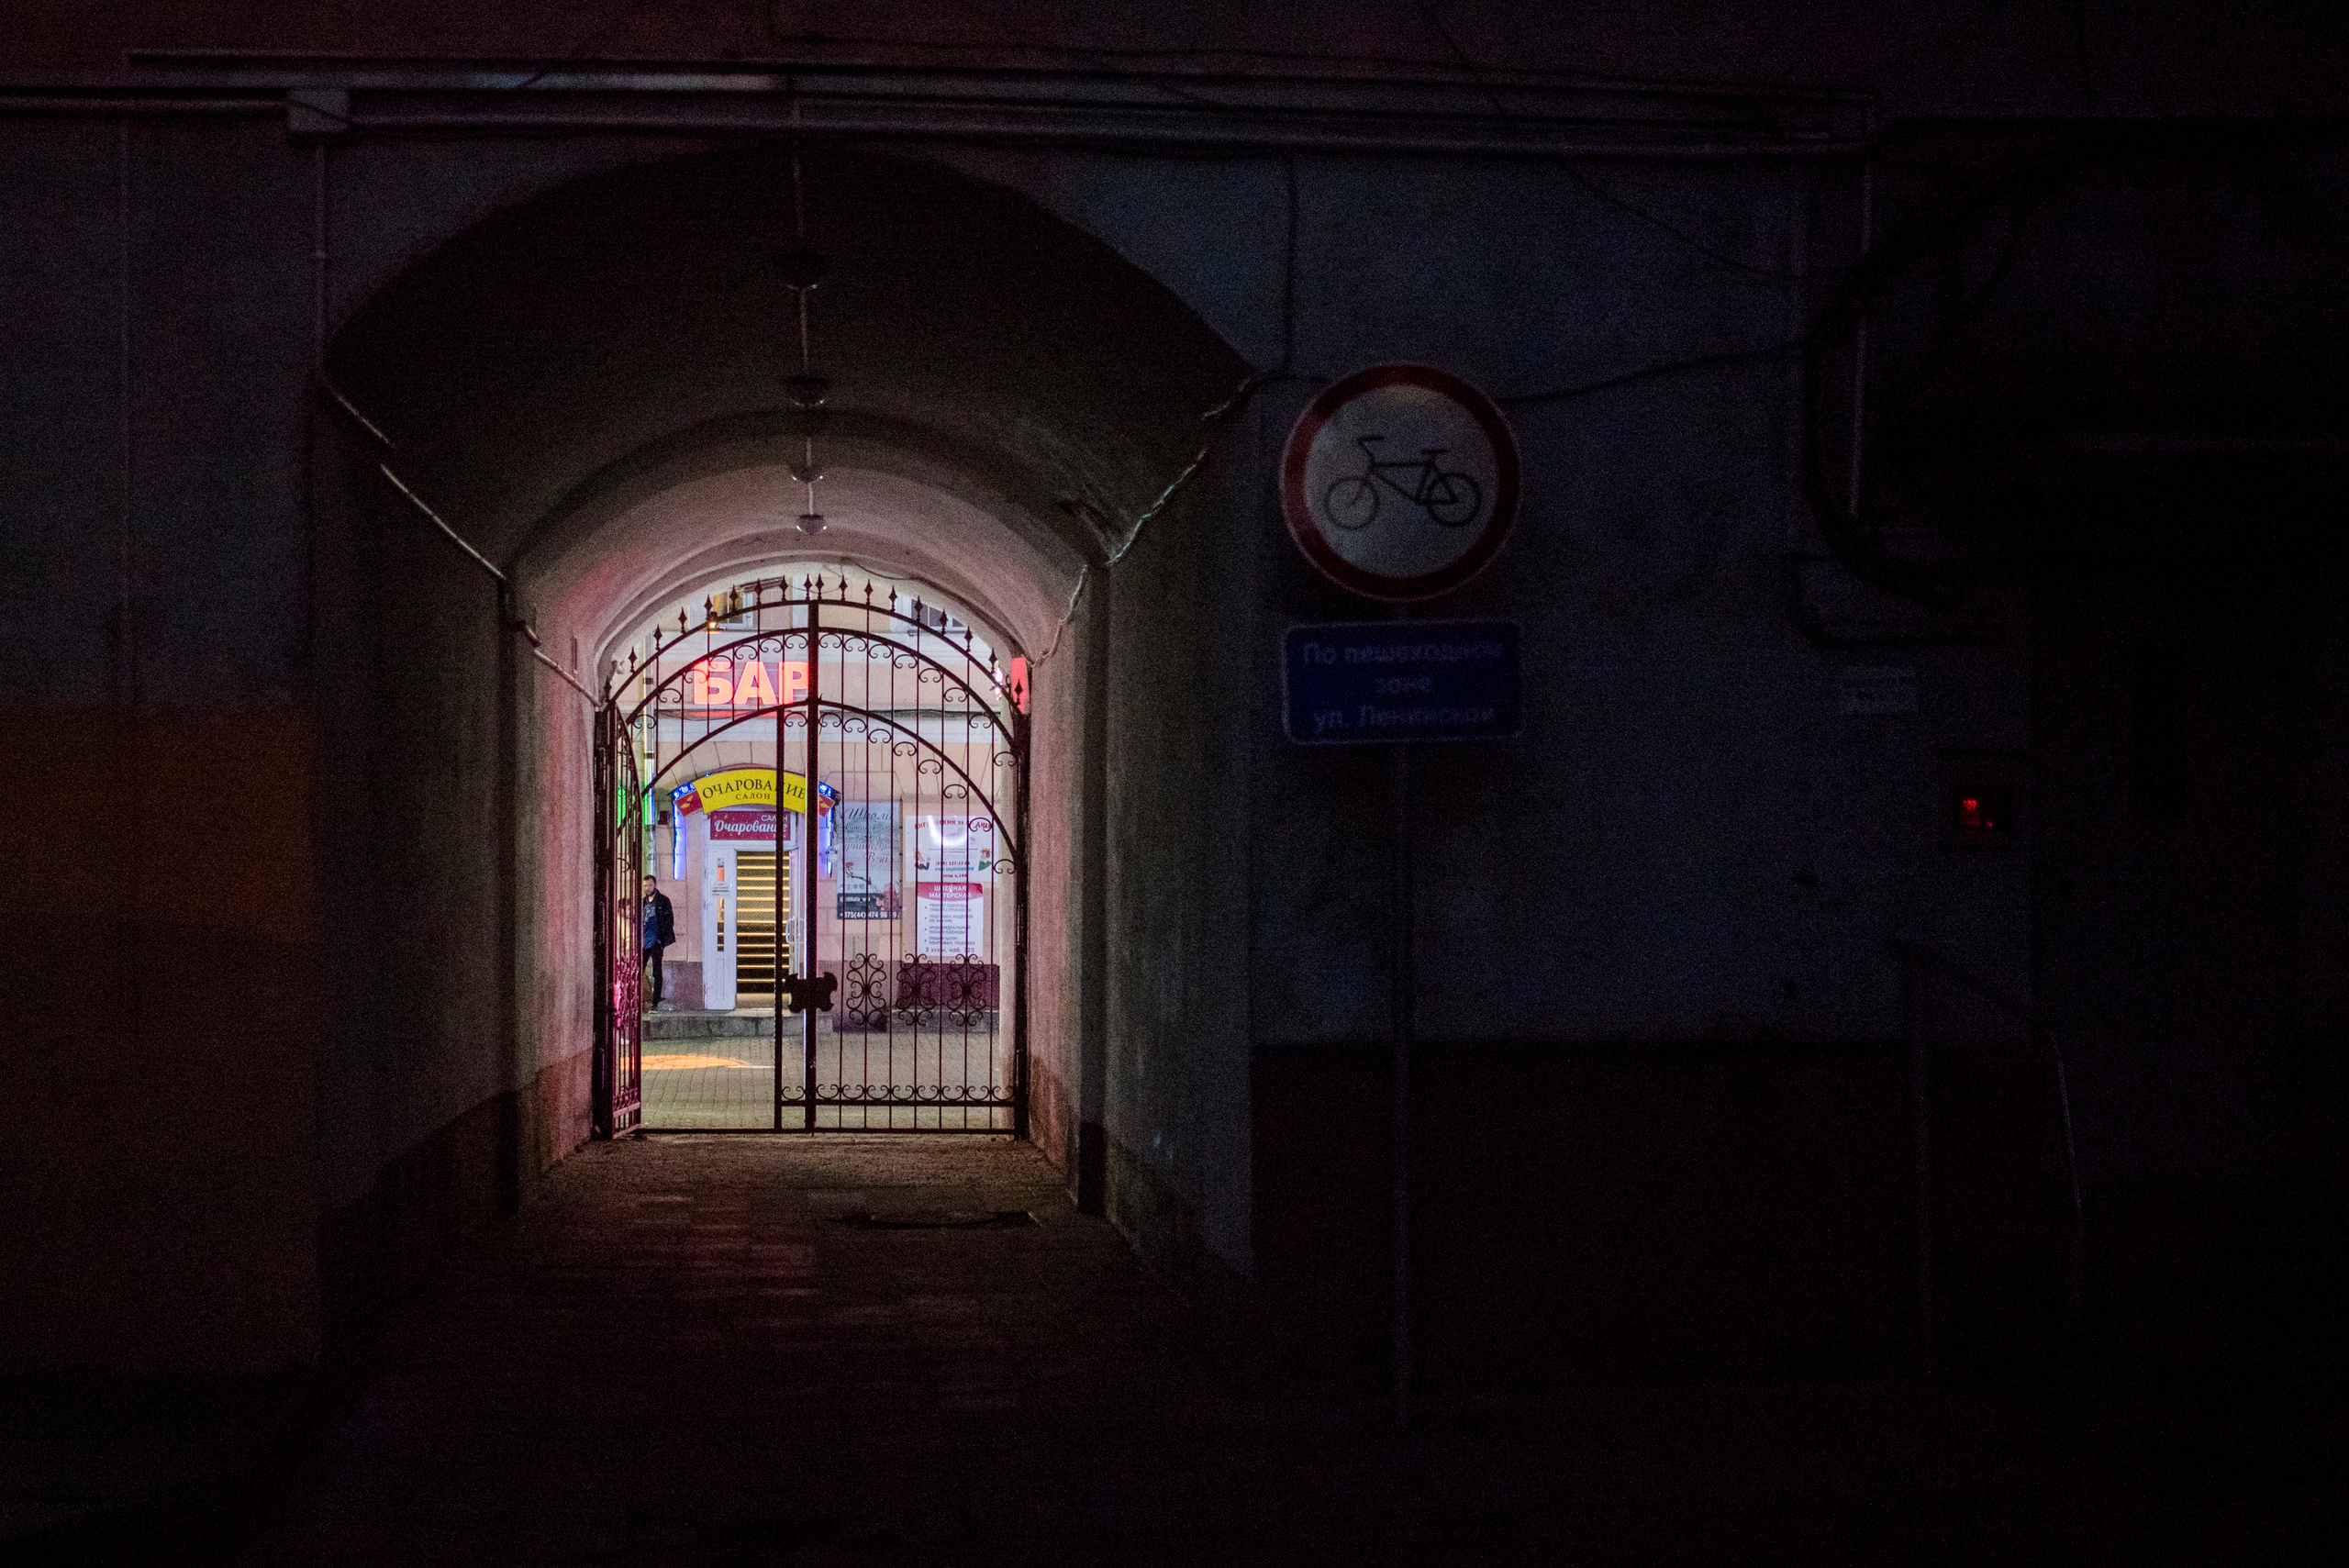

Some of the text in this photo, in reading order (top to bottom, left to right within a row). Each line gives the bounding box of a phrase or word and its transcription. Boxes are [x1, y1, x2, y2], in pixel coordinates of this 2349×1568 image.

[1303, 641, 1337, 665] По
[693, 661, 809, 705] БАР
[702, 778, 806, 800] ОЧАРОВАИЕ
[735, 792, 771, 800] САЛОН
[714, 819, 788, 836] Очароване
